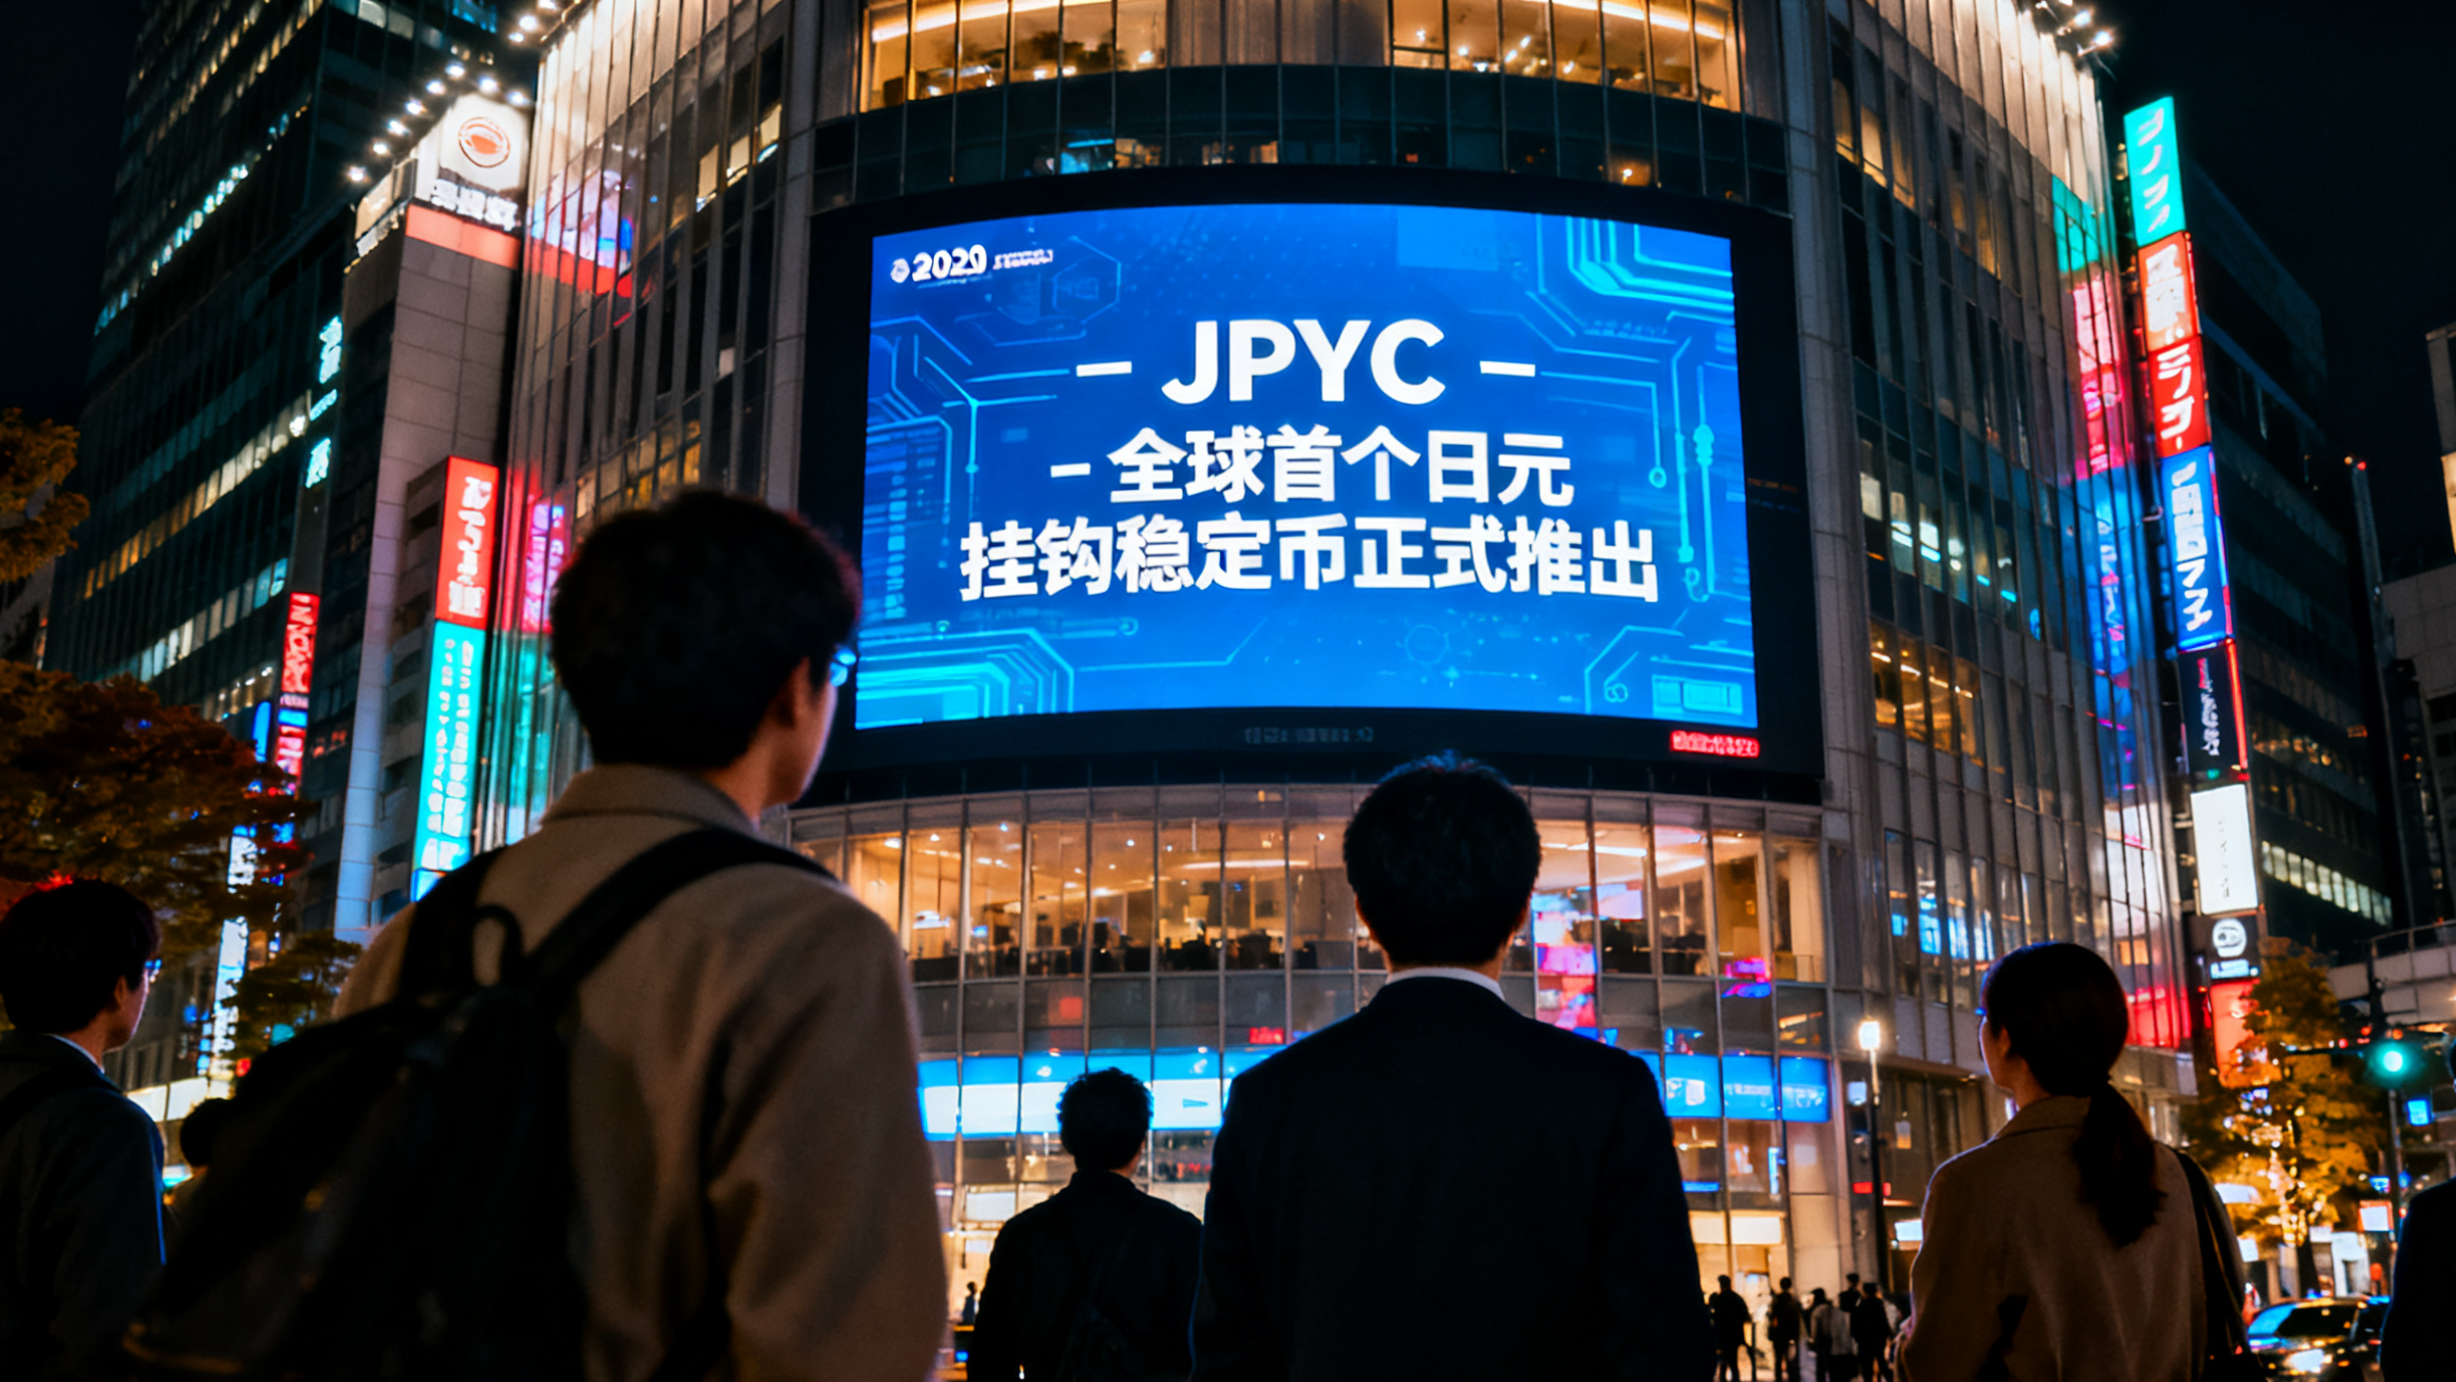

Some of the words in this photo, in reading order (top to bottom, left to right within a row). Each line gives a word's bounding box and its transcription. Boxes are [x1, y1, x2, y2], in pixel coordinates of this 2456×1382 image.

[1161, 318, 1446, 405] JPYC
[1107, 424, 1575, 506] 全球首个日元
[960, 510, 1658, 603] 挂钩稳定币正式推出
